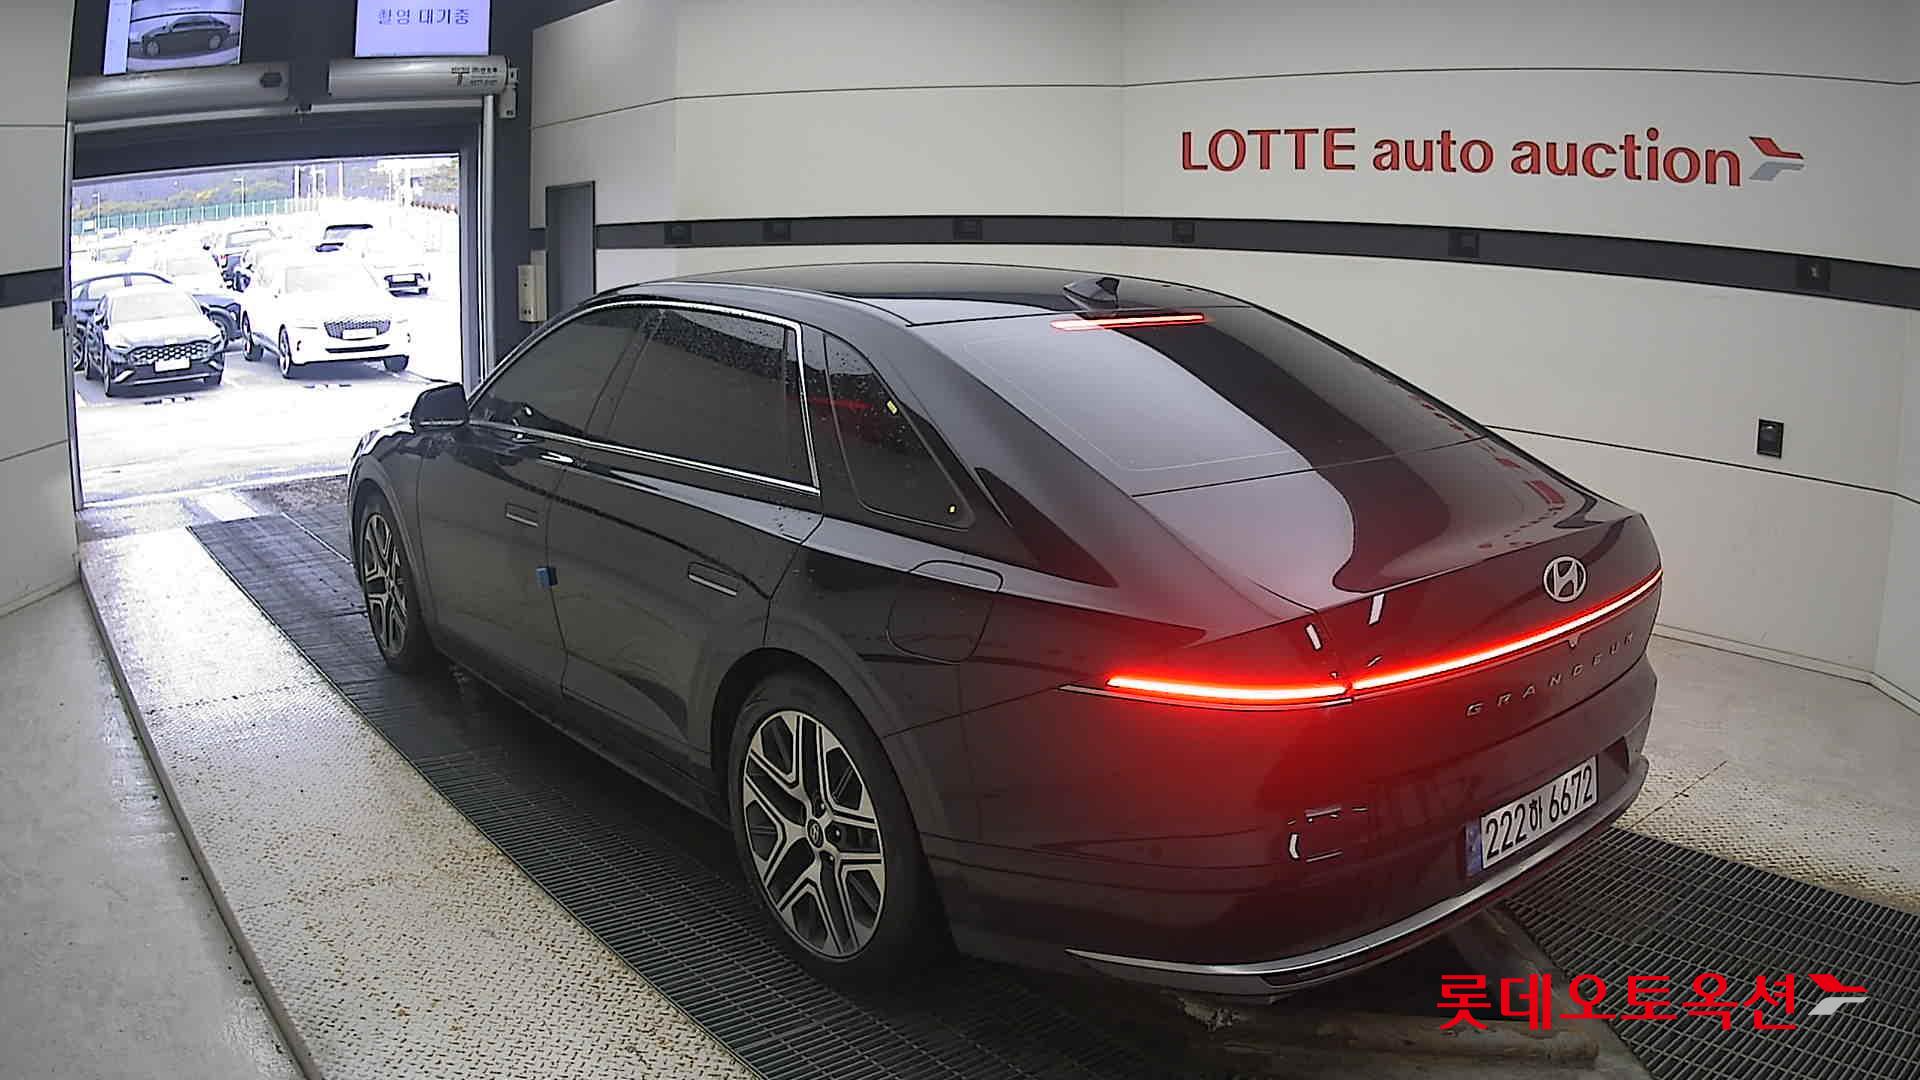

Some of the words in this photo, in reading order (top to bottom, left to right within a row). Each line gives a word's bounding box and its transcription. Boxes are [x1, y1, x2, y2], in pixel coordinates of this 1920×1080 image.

[419, 8, 470, 25] 대기중
[1182, 128, 1356, 172] LOTTE
[1372, 130, 1495, 174] auto
[1511, 127, 1742, 187] auction
[1465, 632, 1633, 717] GRANDEUR
[1549, 765, 1593, 823] 6672
